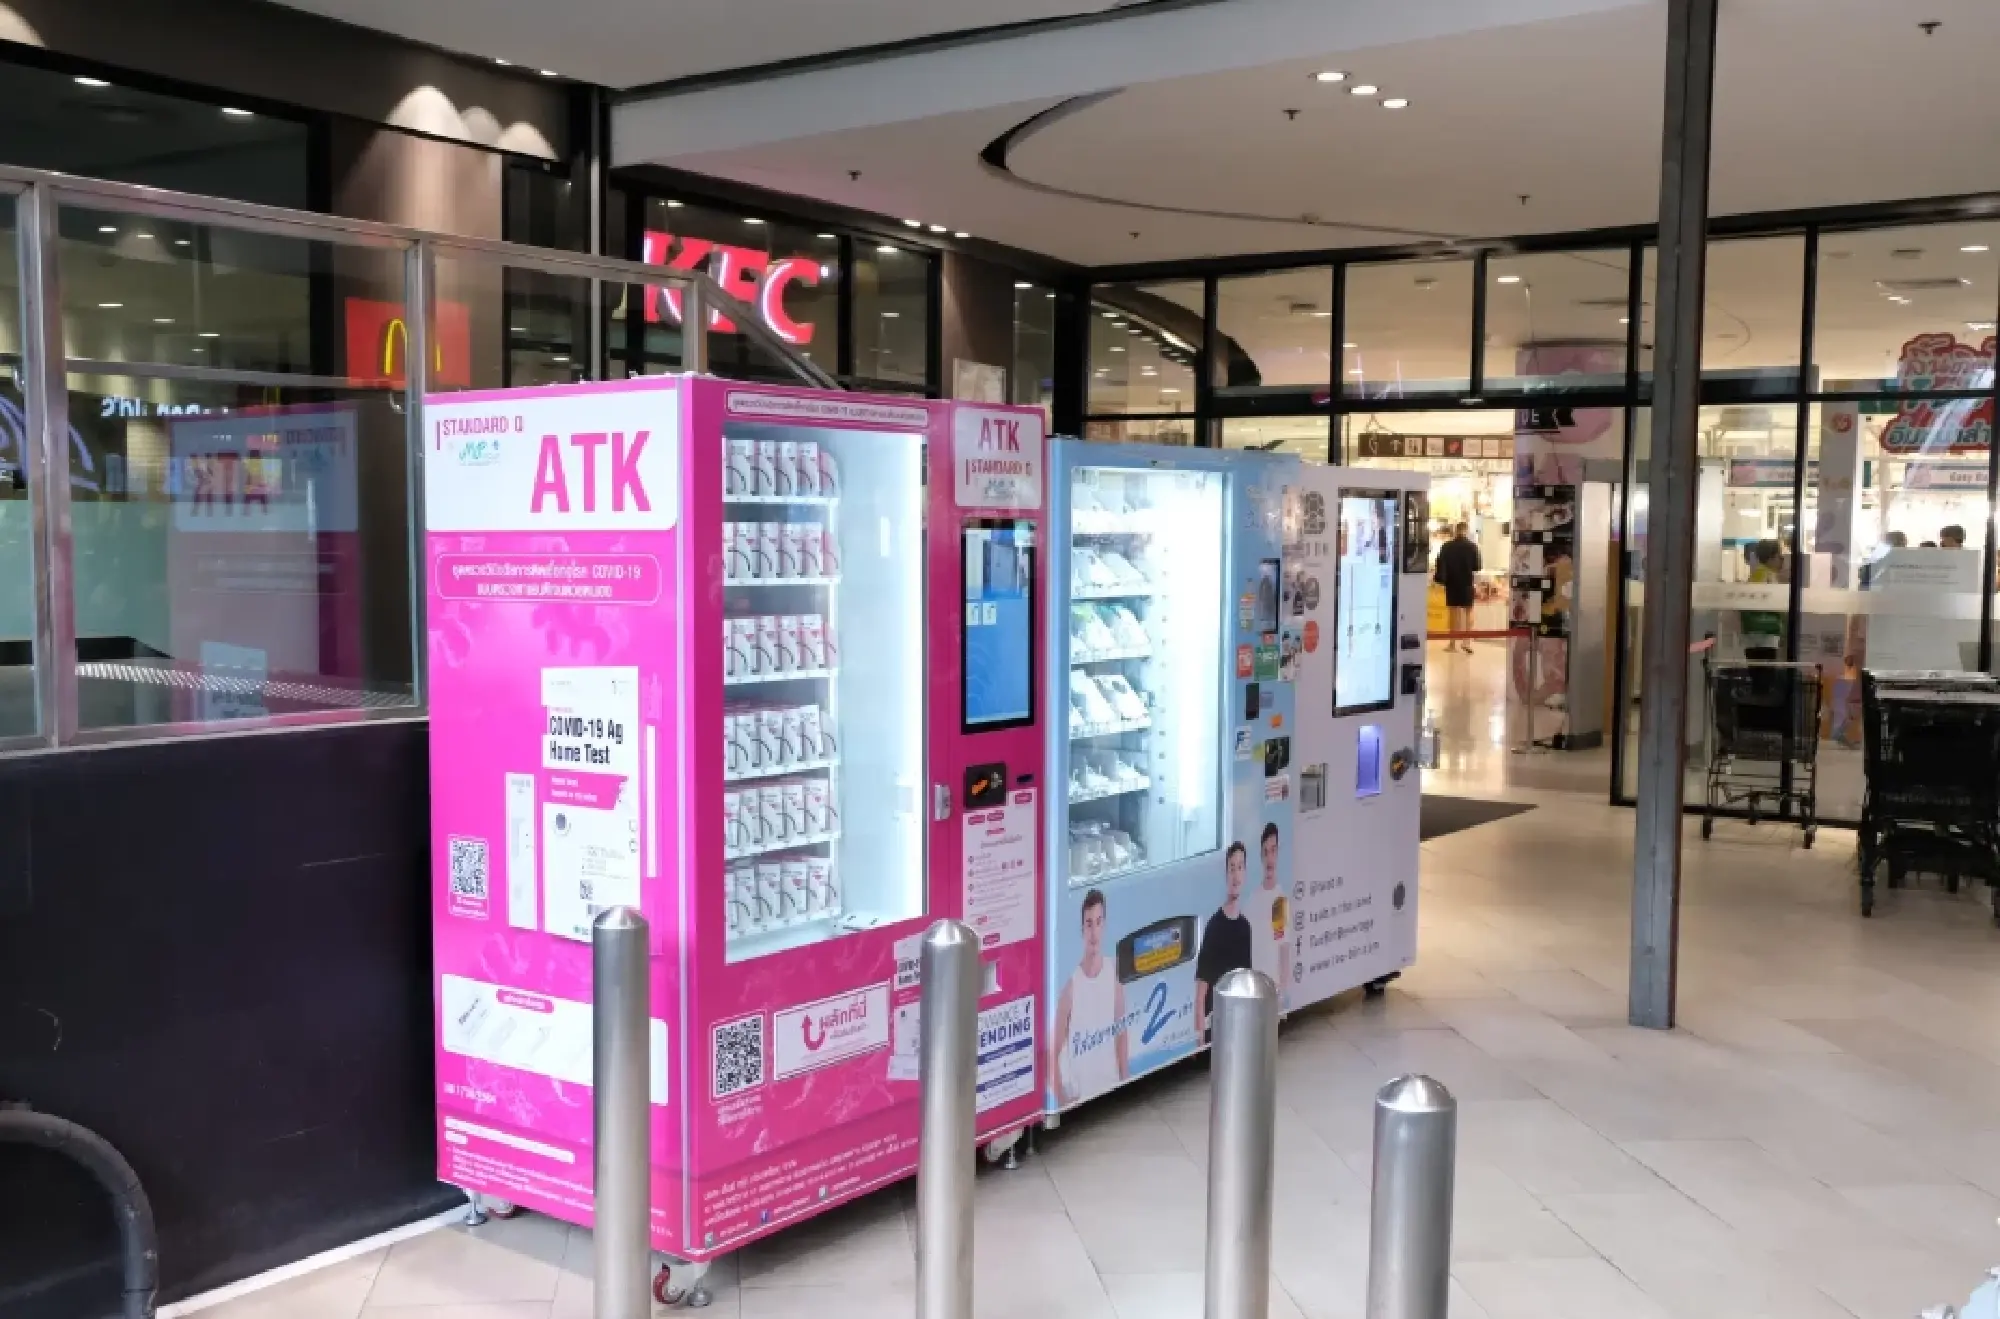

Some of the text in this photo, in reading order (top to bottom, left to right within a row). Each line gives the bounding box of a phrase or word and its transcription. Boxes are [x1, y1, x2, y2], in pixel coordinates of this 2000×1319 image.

[643, 229, 820, 344] KFC
[443, 415, 524, 436] STANDARD Q
[978, 417, 1020, 454] ATK
[530, 430, 652, 513] ATK
[592, 563, 642, 580] COVID-19
[549, 715, 624, 745] COVID-19 Ag
[549, 740, 611, 765] Home Test
[1141, 982, 1177, 1045] 2
[979, 1017, 1031, 1048] ENDING
